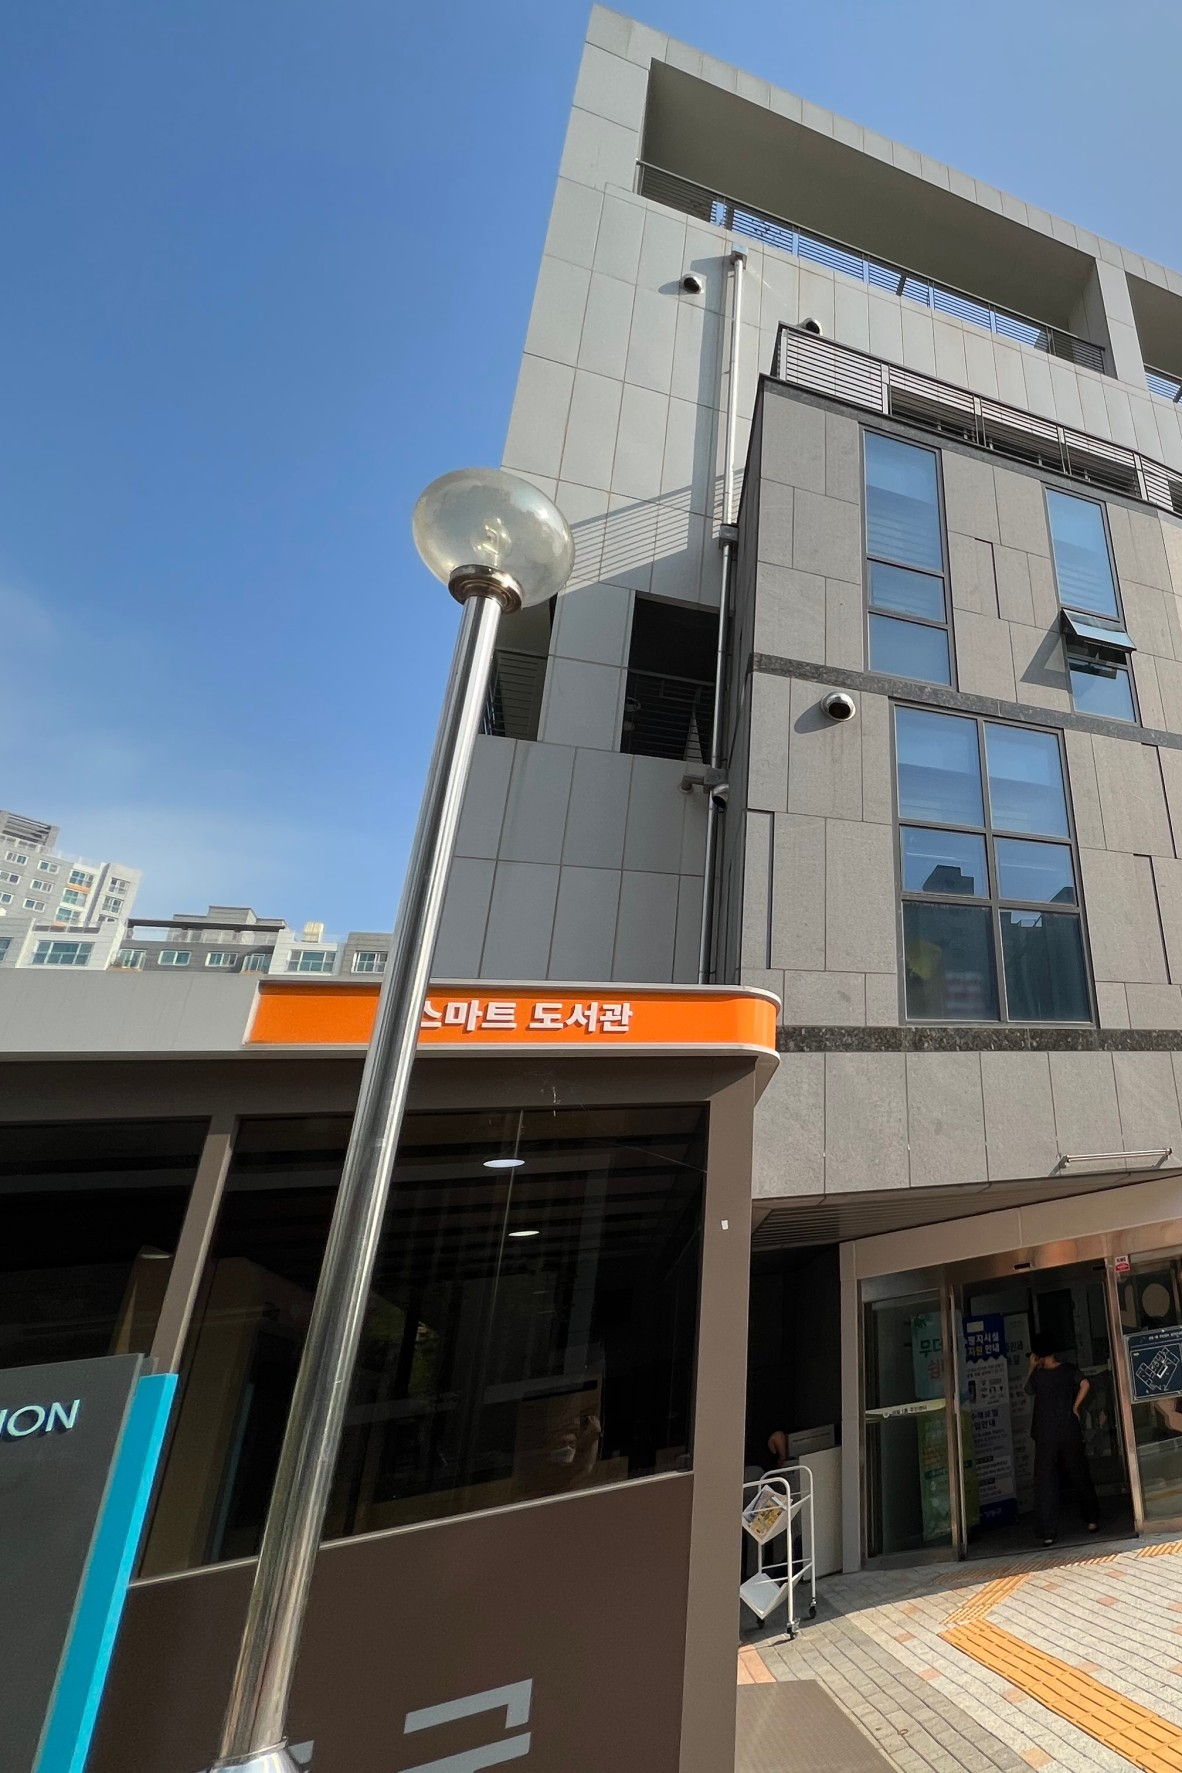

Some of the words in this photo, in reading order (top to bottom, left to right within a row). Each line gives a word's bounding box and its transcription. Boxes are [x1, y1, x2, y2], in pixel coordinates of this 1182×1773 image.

[421, 1000, 516, 1031] 스마트
[529, 1001, 633, 1032] 도서관
[985, 1343, 999, 1354] 안내
[0, 1399, 80, 1437] ION
